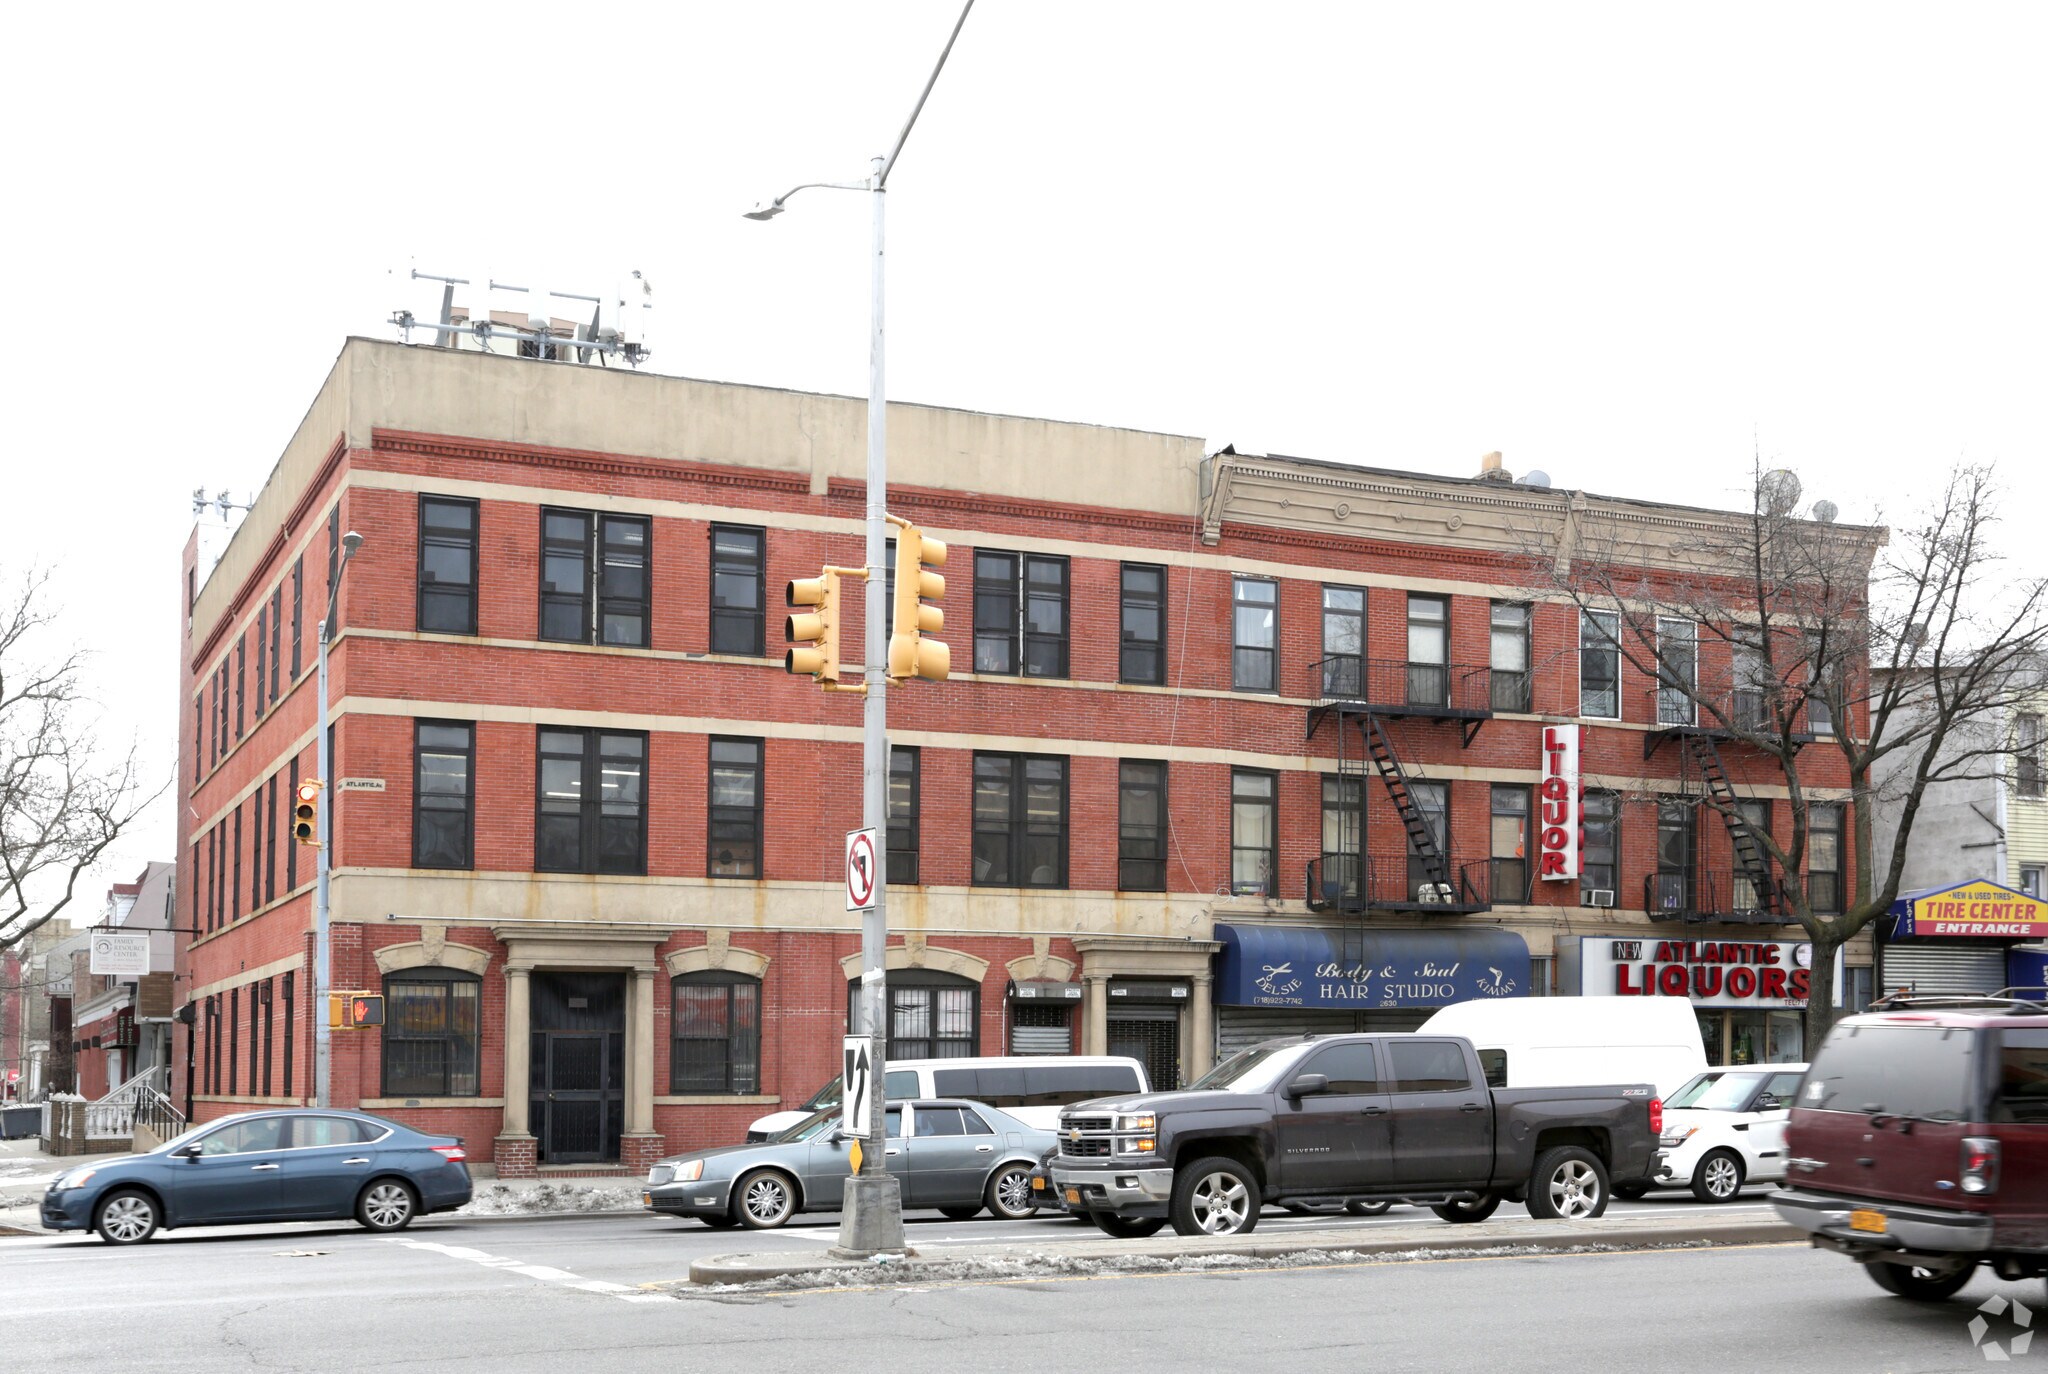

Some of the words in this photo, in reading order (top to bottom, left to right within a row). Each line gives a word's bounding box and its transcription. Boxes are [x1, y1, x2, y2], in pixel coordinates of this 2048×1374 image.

[1542, 728, 1568, 874] LIQUOR
[1975, 892, 1991, 900] USED
[1926, 902, 1966, 919] TIRE
[1969, 902, 2037, 920] CENTER
[1935, 923, 2031, 934] ENTRANCE
[1617, 942, 1643, 959] NEW
[1653, 942, 1781, 964] ATLANTIC
[1315, 962, 1373, 983] Body
[1380, 965, 1396, 978] &
[1415, 962, 1460, 977] Soul
[1616, 964, 1811, 999] LIQUORS
[1255, 977, 1302, 995] DELSIE
[1320, 984, 1369, 999] HAIR
[1384, 984, 1455, 998] STUDIO
[1476, 978, 1516, 996] KIMMY
